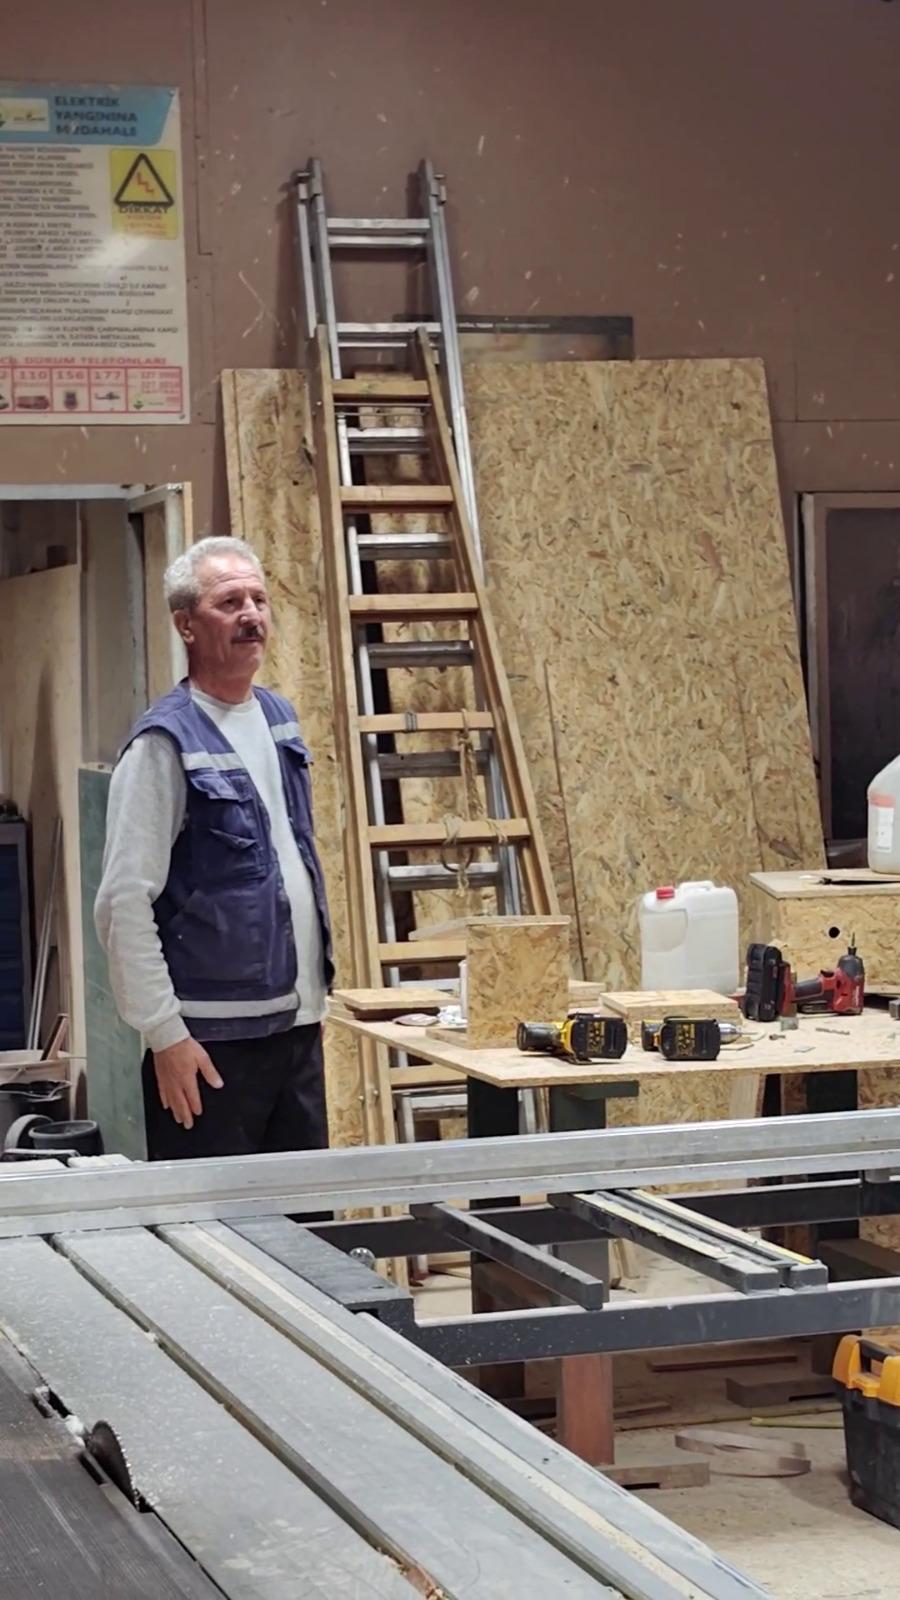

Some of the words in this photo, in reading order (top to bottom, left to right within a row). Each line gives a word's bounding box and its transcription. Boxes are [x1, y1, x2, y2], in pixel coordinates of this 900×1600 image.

[55, 95, 120, 107] ELEKTRİK
[20, 371, 48, 380] 110
[57, 371, 84, 380] 156
[95, 371, 121, 380] 177
